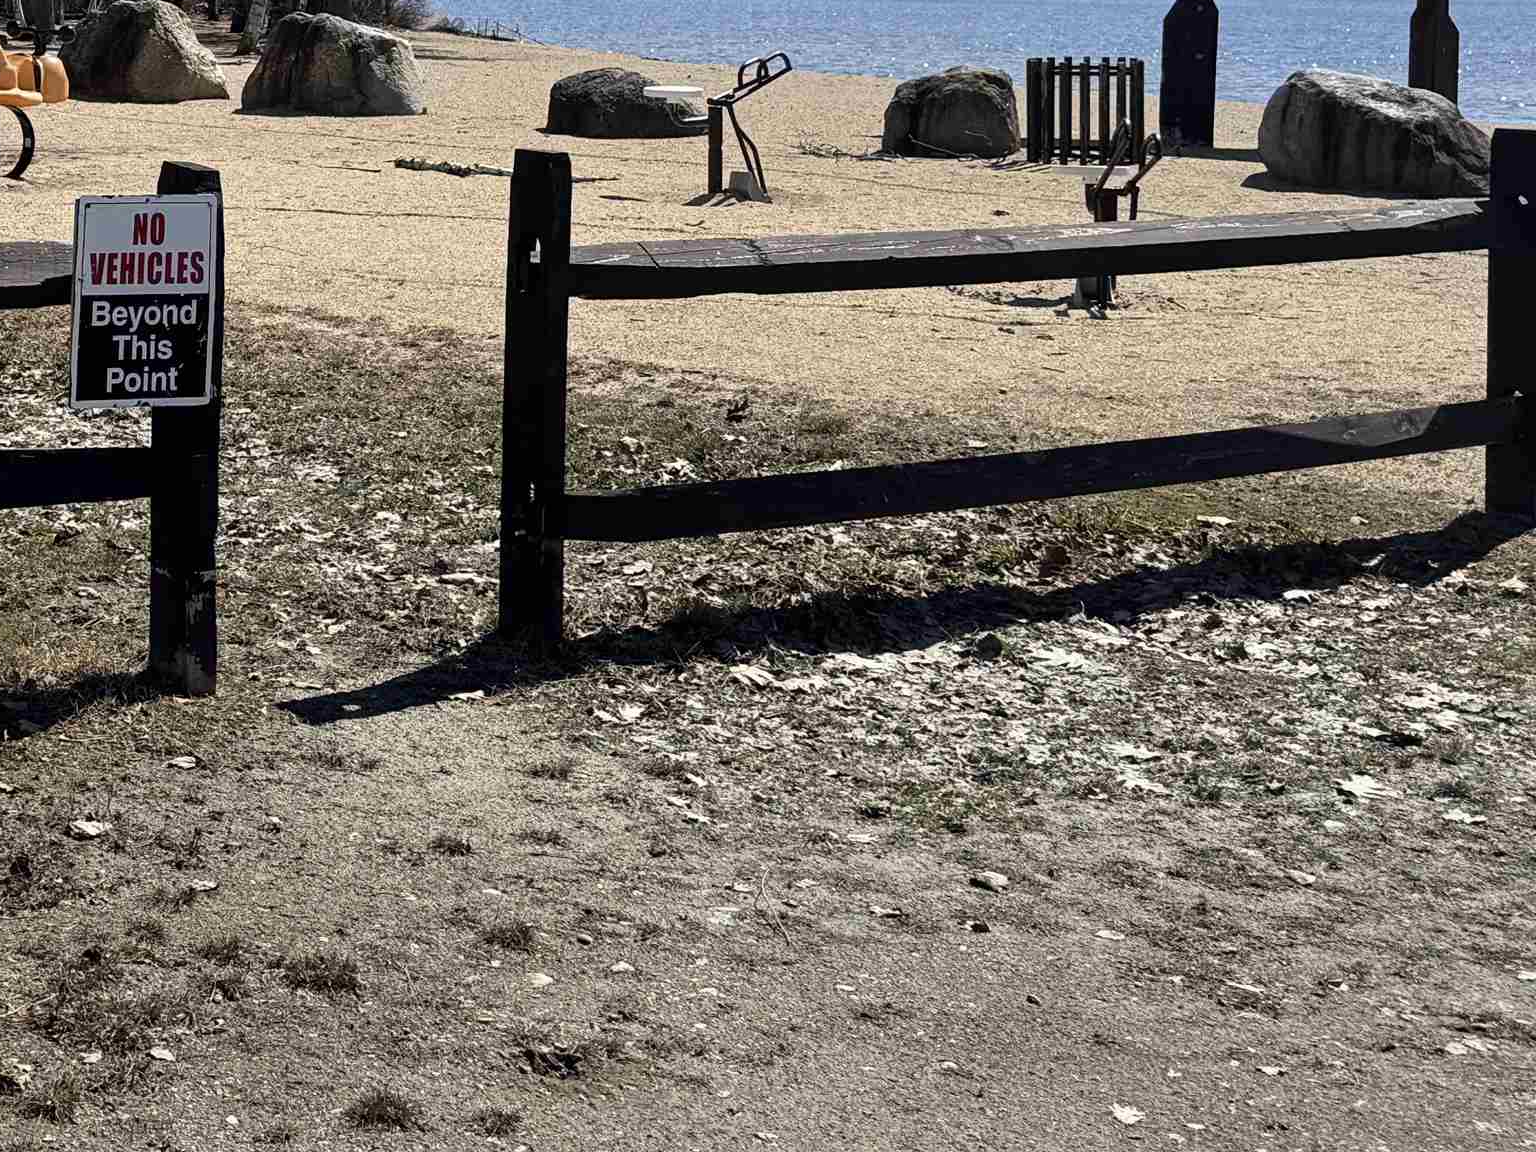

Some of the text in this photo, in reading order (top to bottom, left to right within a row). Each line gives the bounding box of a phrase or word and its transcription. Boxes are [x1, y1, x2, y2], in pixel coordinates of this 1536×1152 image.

[132, 211, 166, 246] NO
[89, 251, 205, 286] VEHICLES
[91, 299, 197, 333] Beyond
[112, 334, 173, 361] This
[106, 365, 179, 393] Point
